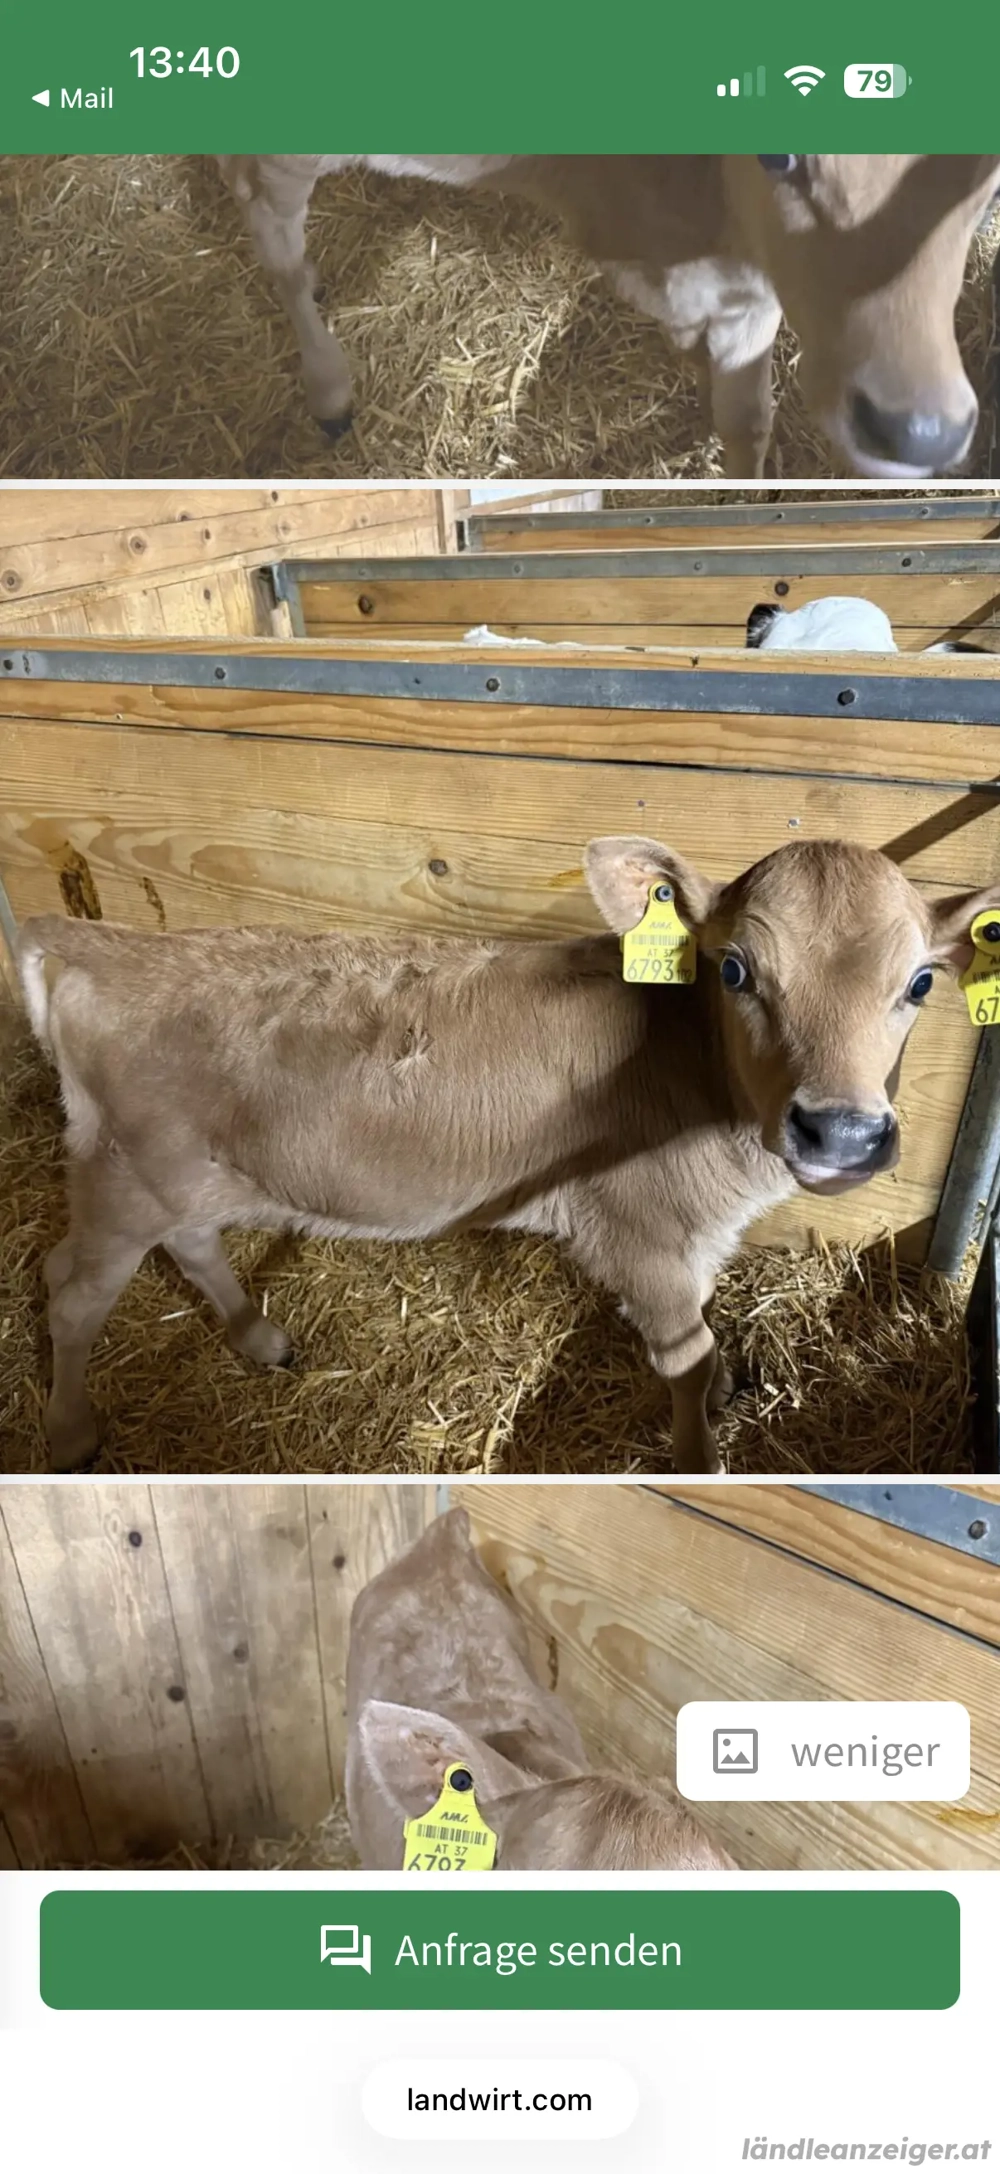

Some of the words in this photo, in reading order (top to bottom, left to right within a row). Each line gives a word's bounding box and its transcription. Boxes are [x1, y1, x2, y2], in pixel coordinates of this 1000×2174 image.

[129, 45, 241, 79] 13:40
[857, 71, 892, 93] 79
[60, 87, 114, 109] Mail
[627, 959, 674, 981] 6793
[790, 1734, 941, 1777] weniger
[434, 1844, 449, 1854] AT
[454, 1845, 469, 1857] 37
[394, 1932, 538, 1976] Anfrage
[547, 1932, 682, 1967] senden
[407, 2086, 592, 2112] landwirt.com
